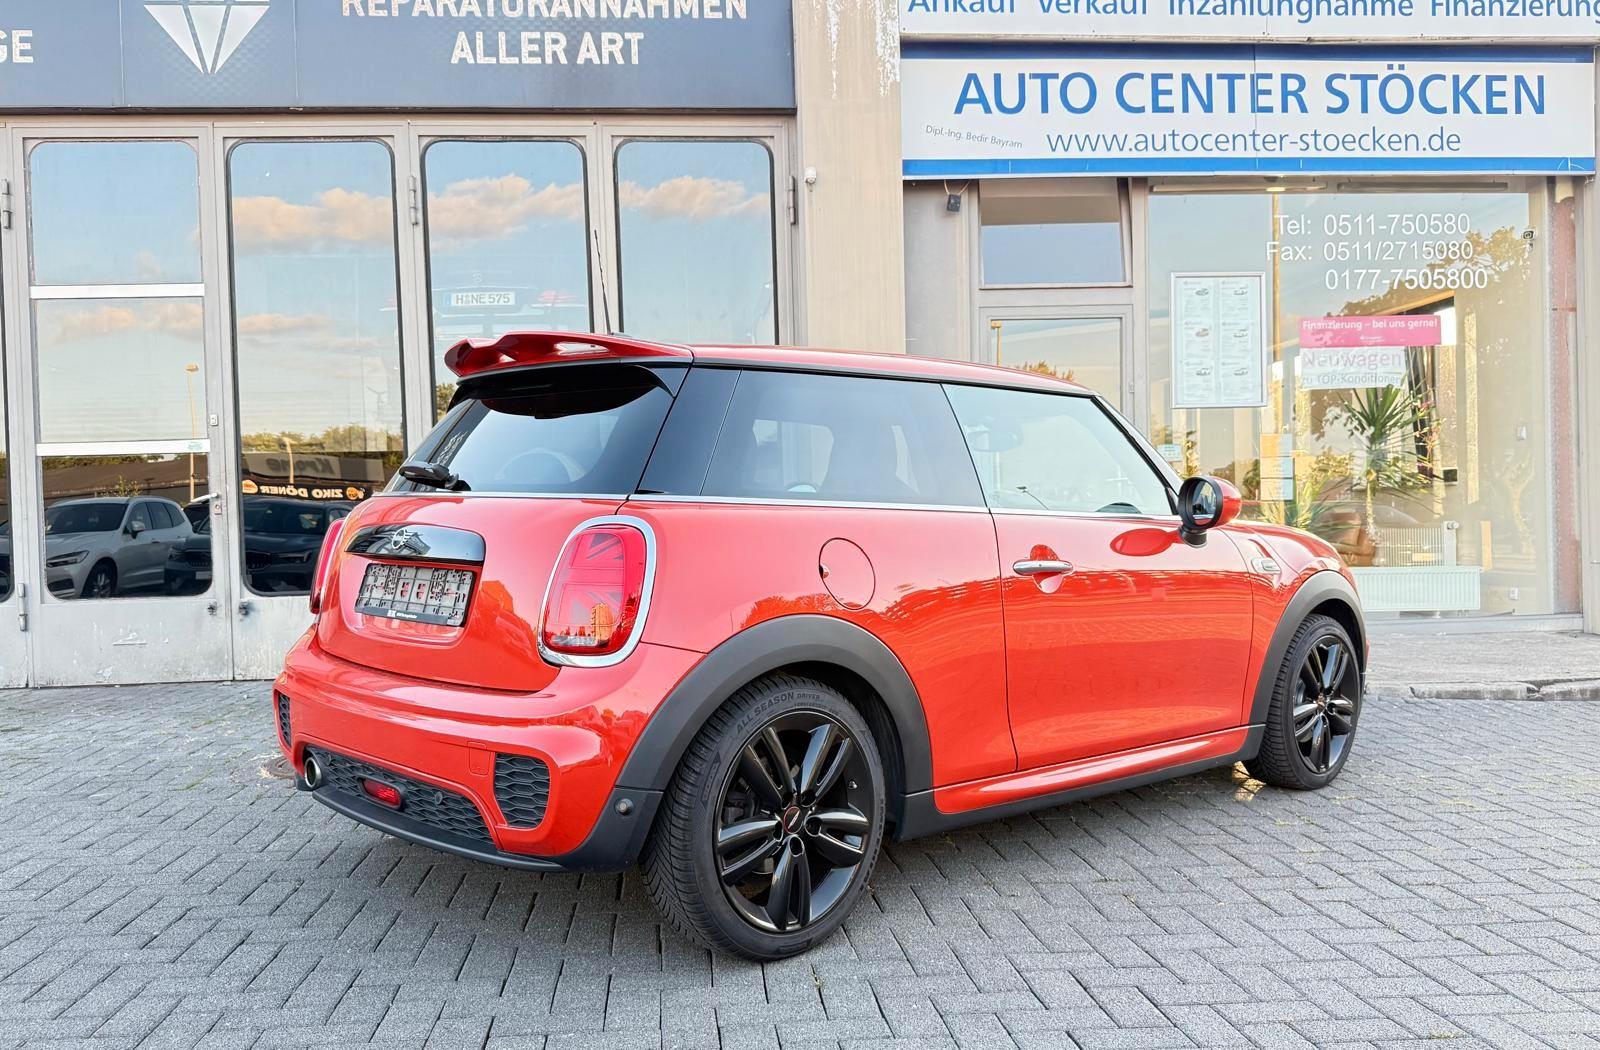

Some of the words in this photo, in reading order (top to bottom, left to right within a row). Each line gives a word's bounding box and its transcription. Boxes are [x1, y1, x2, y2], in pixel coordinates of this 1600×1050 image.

[451, 31, 568, 64] ALLER
[576, 32, 644, 65] ART
[954, 72, 1098, 115] AUTO
[1115, 72, 1309, 114] CENTER
[1324, 64, 1545, 115] STÖCKEN
[966, 131, 989, 143] Bedir
[990, 136, 1023, 149] Bayram
[1047, 126, 1461, 152] www.autocenter-stoecken.de
[1274, 215, 1312, 236] Tel:
[1323, 213, 1471, 236] 0511-750580
[1266, 241, 1313, 261] Fax:
[1323, 240, 1473, 261] 0511/2715080
[1325, 268, 1488, 290] 0177-7505800
[1302, 319, 1362, 331] Finanzierung
